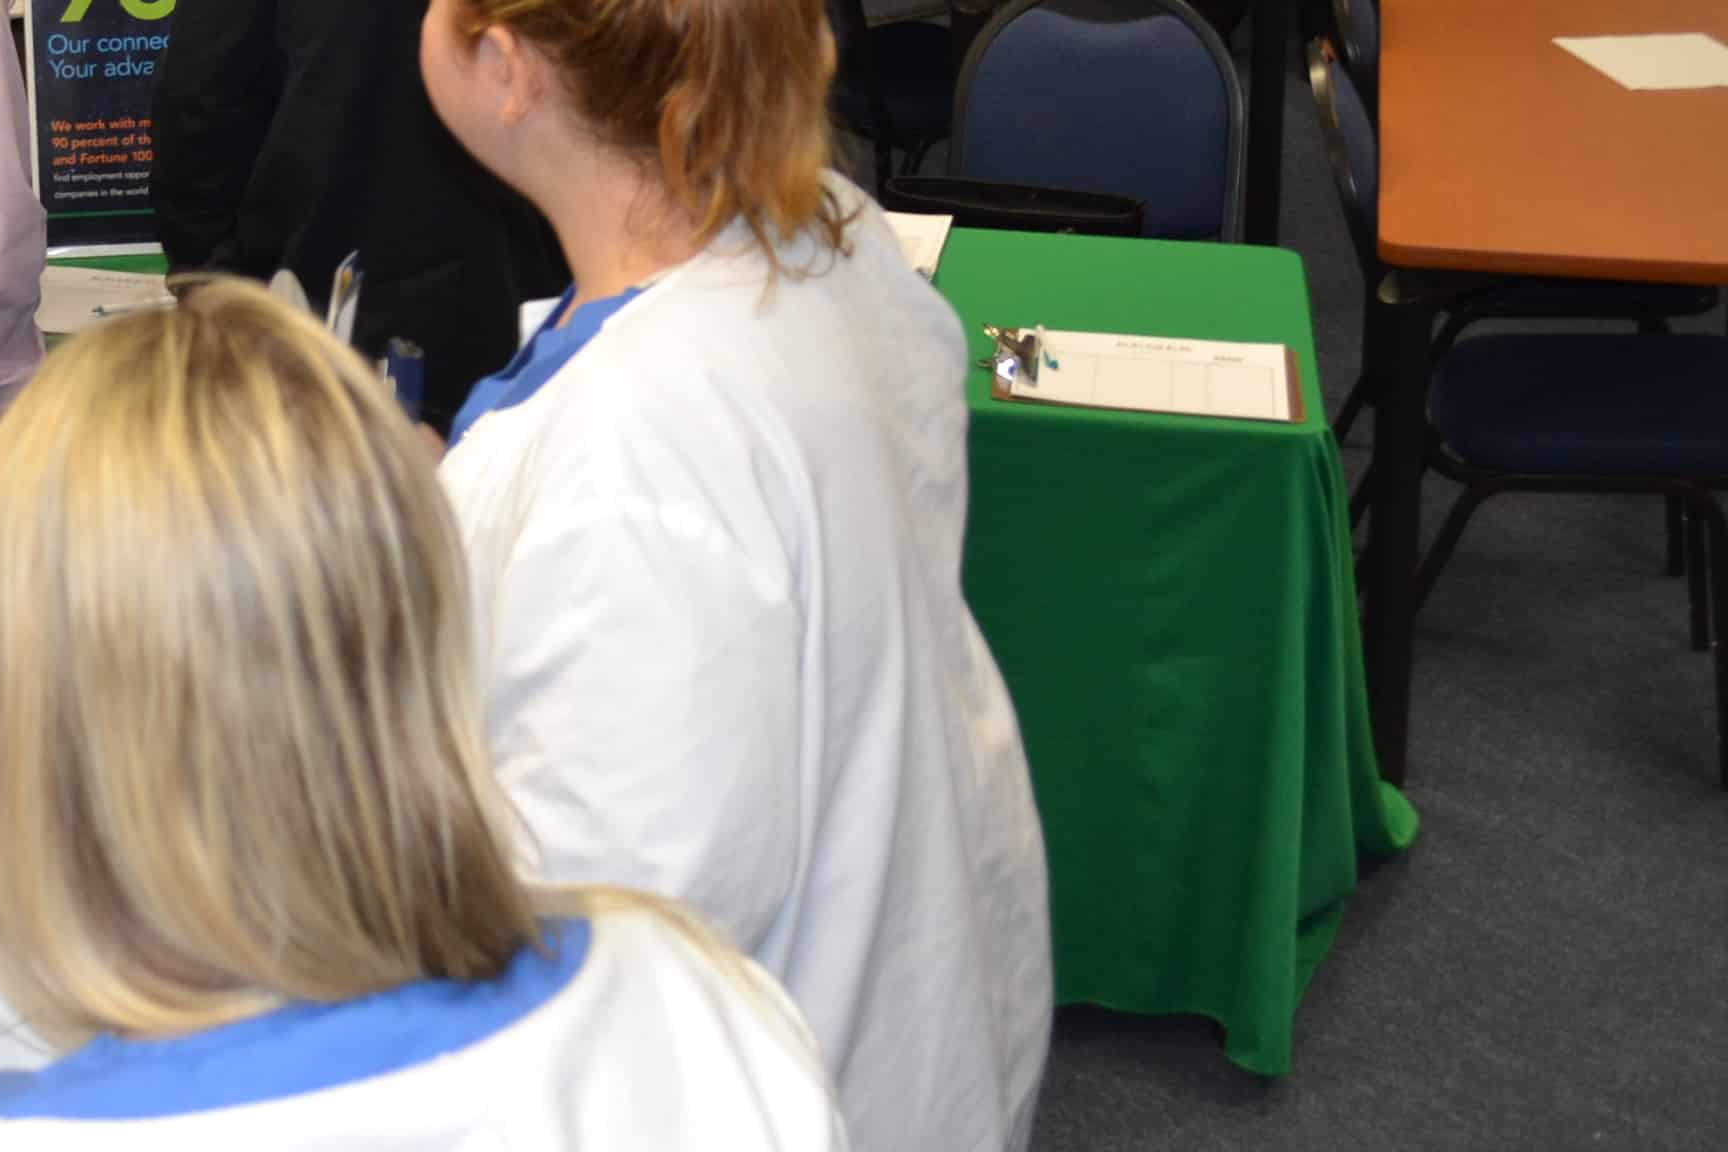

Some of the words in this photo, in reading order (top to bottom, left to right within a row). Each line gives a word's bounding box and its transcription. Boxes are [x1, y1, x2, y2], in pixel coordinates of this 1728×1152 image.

[48, 33, 91, 55] Our
[49, 58, 97, 79] Your
[51, 119, 72, 132] We
[74, 118, 106, 131] work
[109, 116, 136, 129] with
[51, 136, 70, 149] 90
[71, 134, 118, 150] percent
[120, 132, 136, 146] of
[52, 150, 77, 166] and
[79, 151, 129, 165] Fortune
[71, 171, 123, 184] employment
[53, 190, 99, 199] companies
[110, 188, 123, 198] the
[125, 185, 149, 196] world
